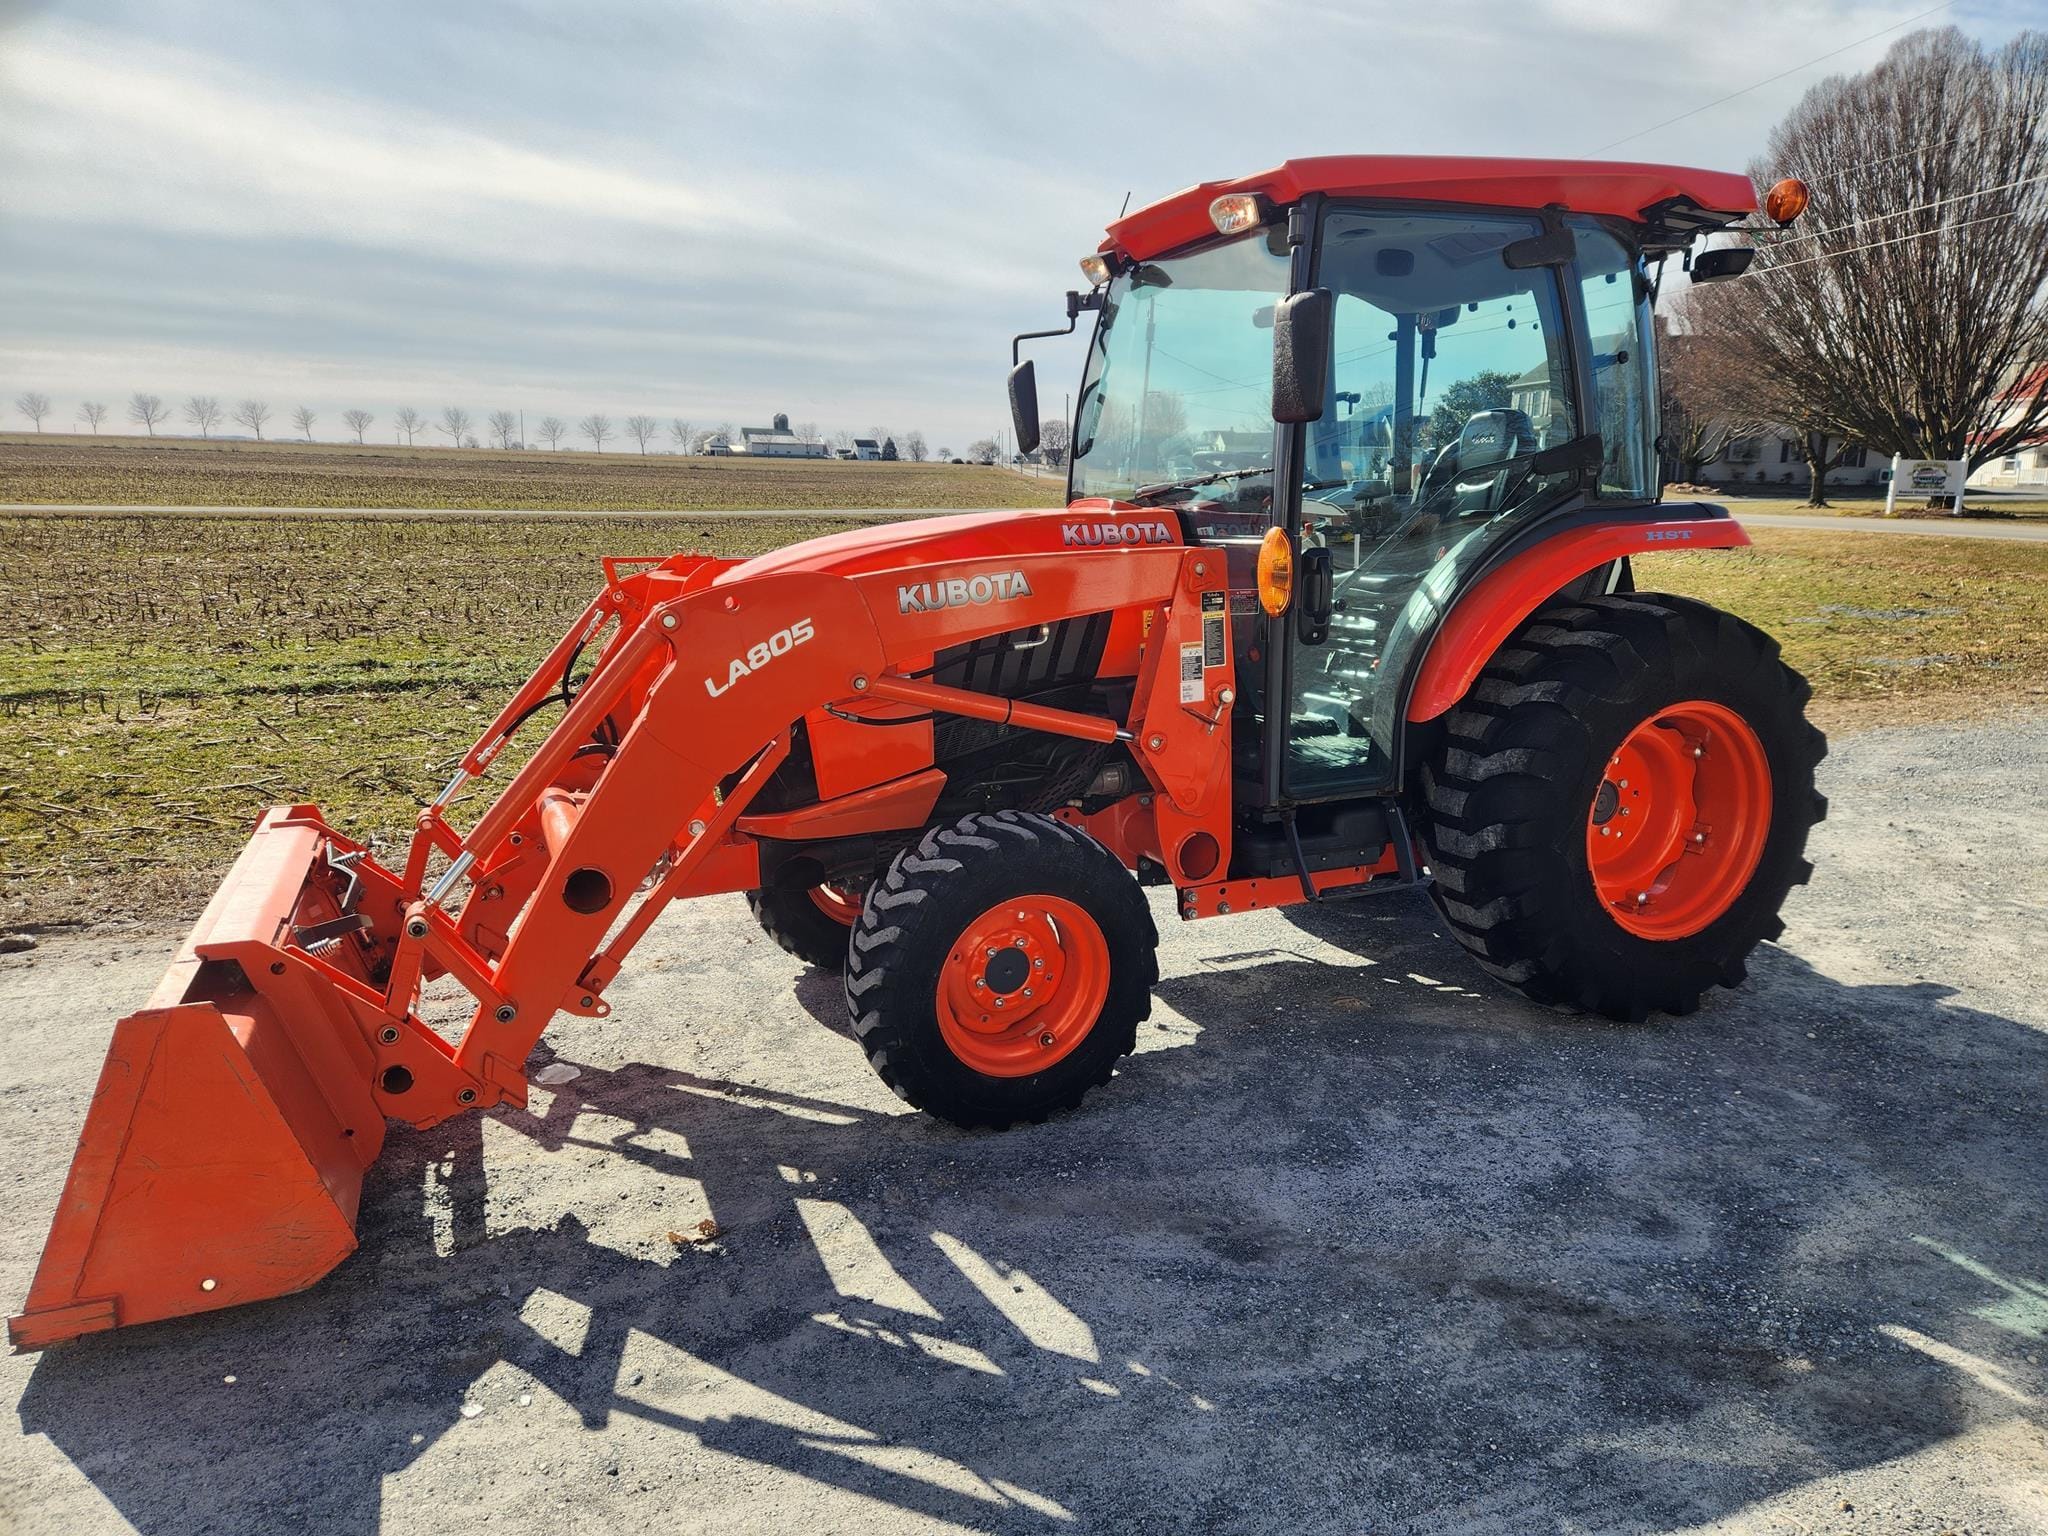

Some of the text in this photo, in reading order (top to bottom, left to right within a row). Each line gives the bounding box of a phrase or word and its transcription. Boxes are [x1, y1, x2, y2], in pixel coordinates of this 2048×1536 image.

[1061, 522, 1174, 546] KUBOTA
[1646, 529, 1693, 541] HST
[897, 570, 1033, 614] KUBOTA
[704, 617, 815, 698] LA805
